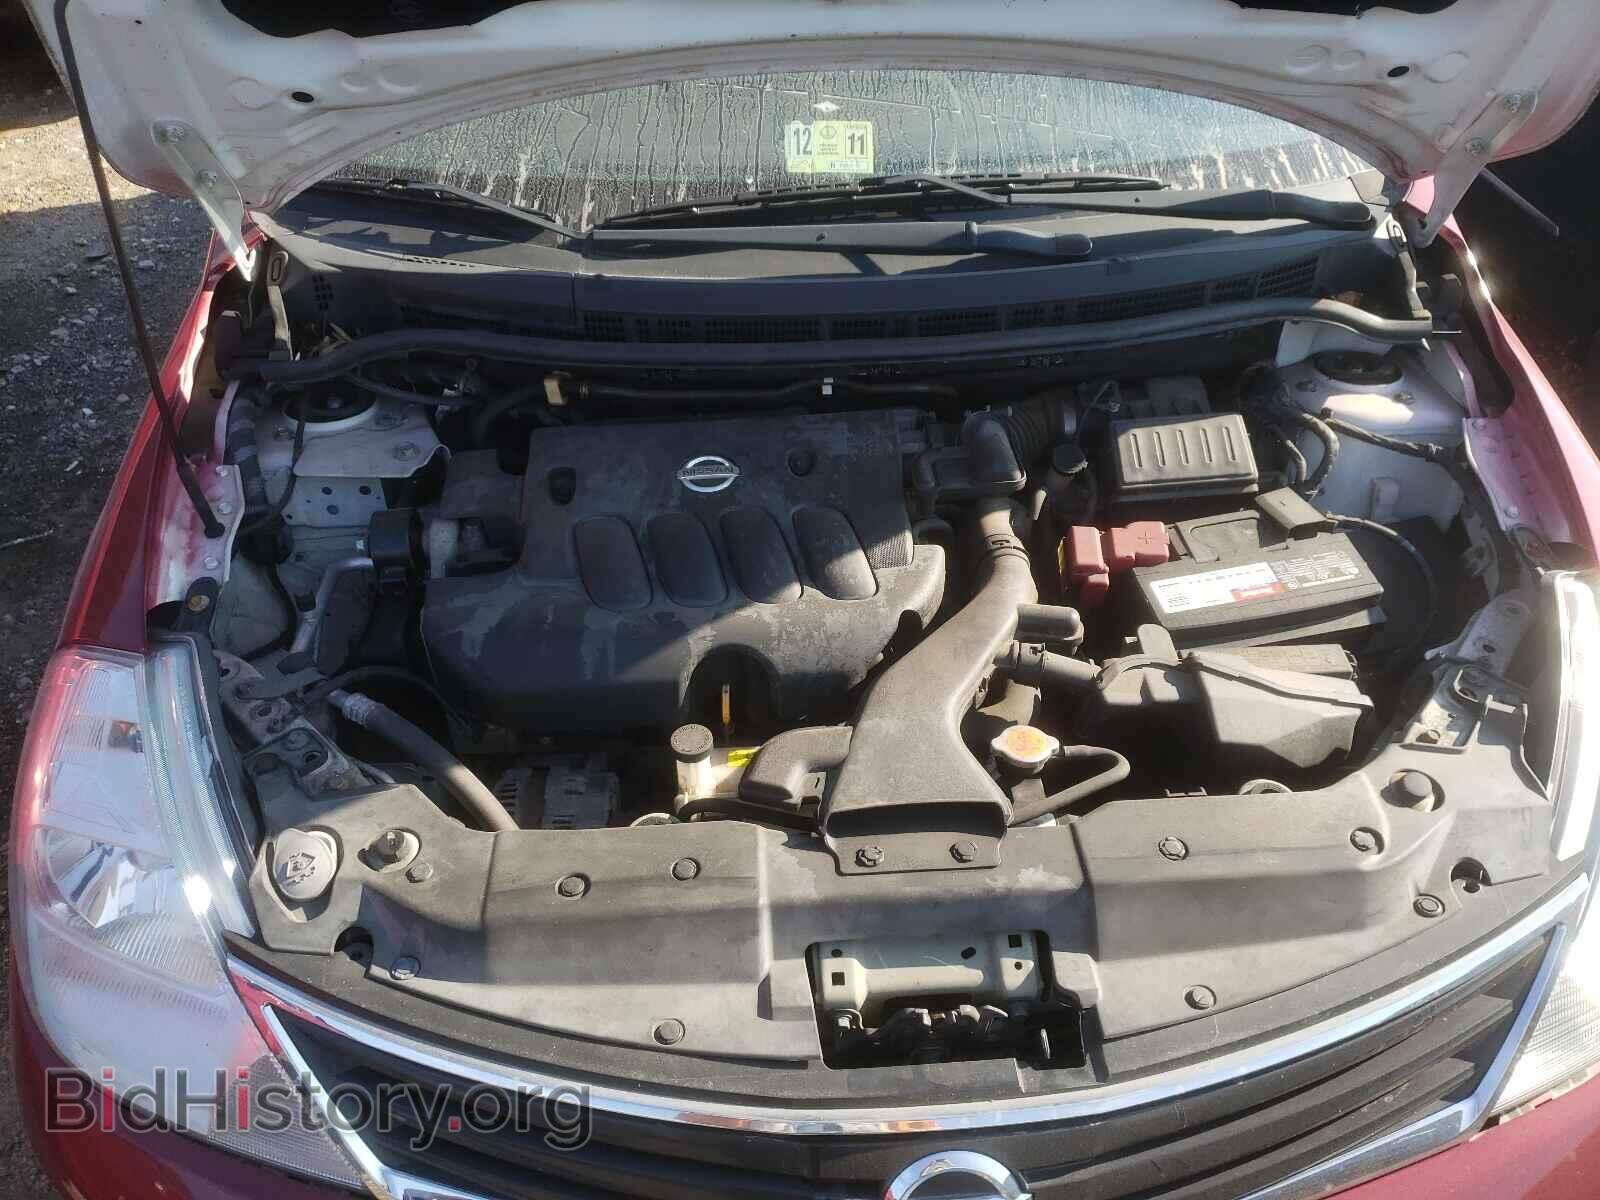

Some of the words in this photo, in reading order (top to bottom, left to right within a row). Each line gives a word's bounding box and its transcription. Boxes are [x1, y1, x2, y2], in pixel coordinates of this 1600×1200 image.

[793, 127, 812, 155] 12
[847, 133, 865, 156] 11
[681, 465, 734, 477] NISSAN
